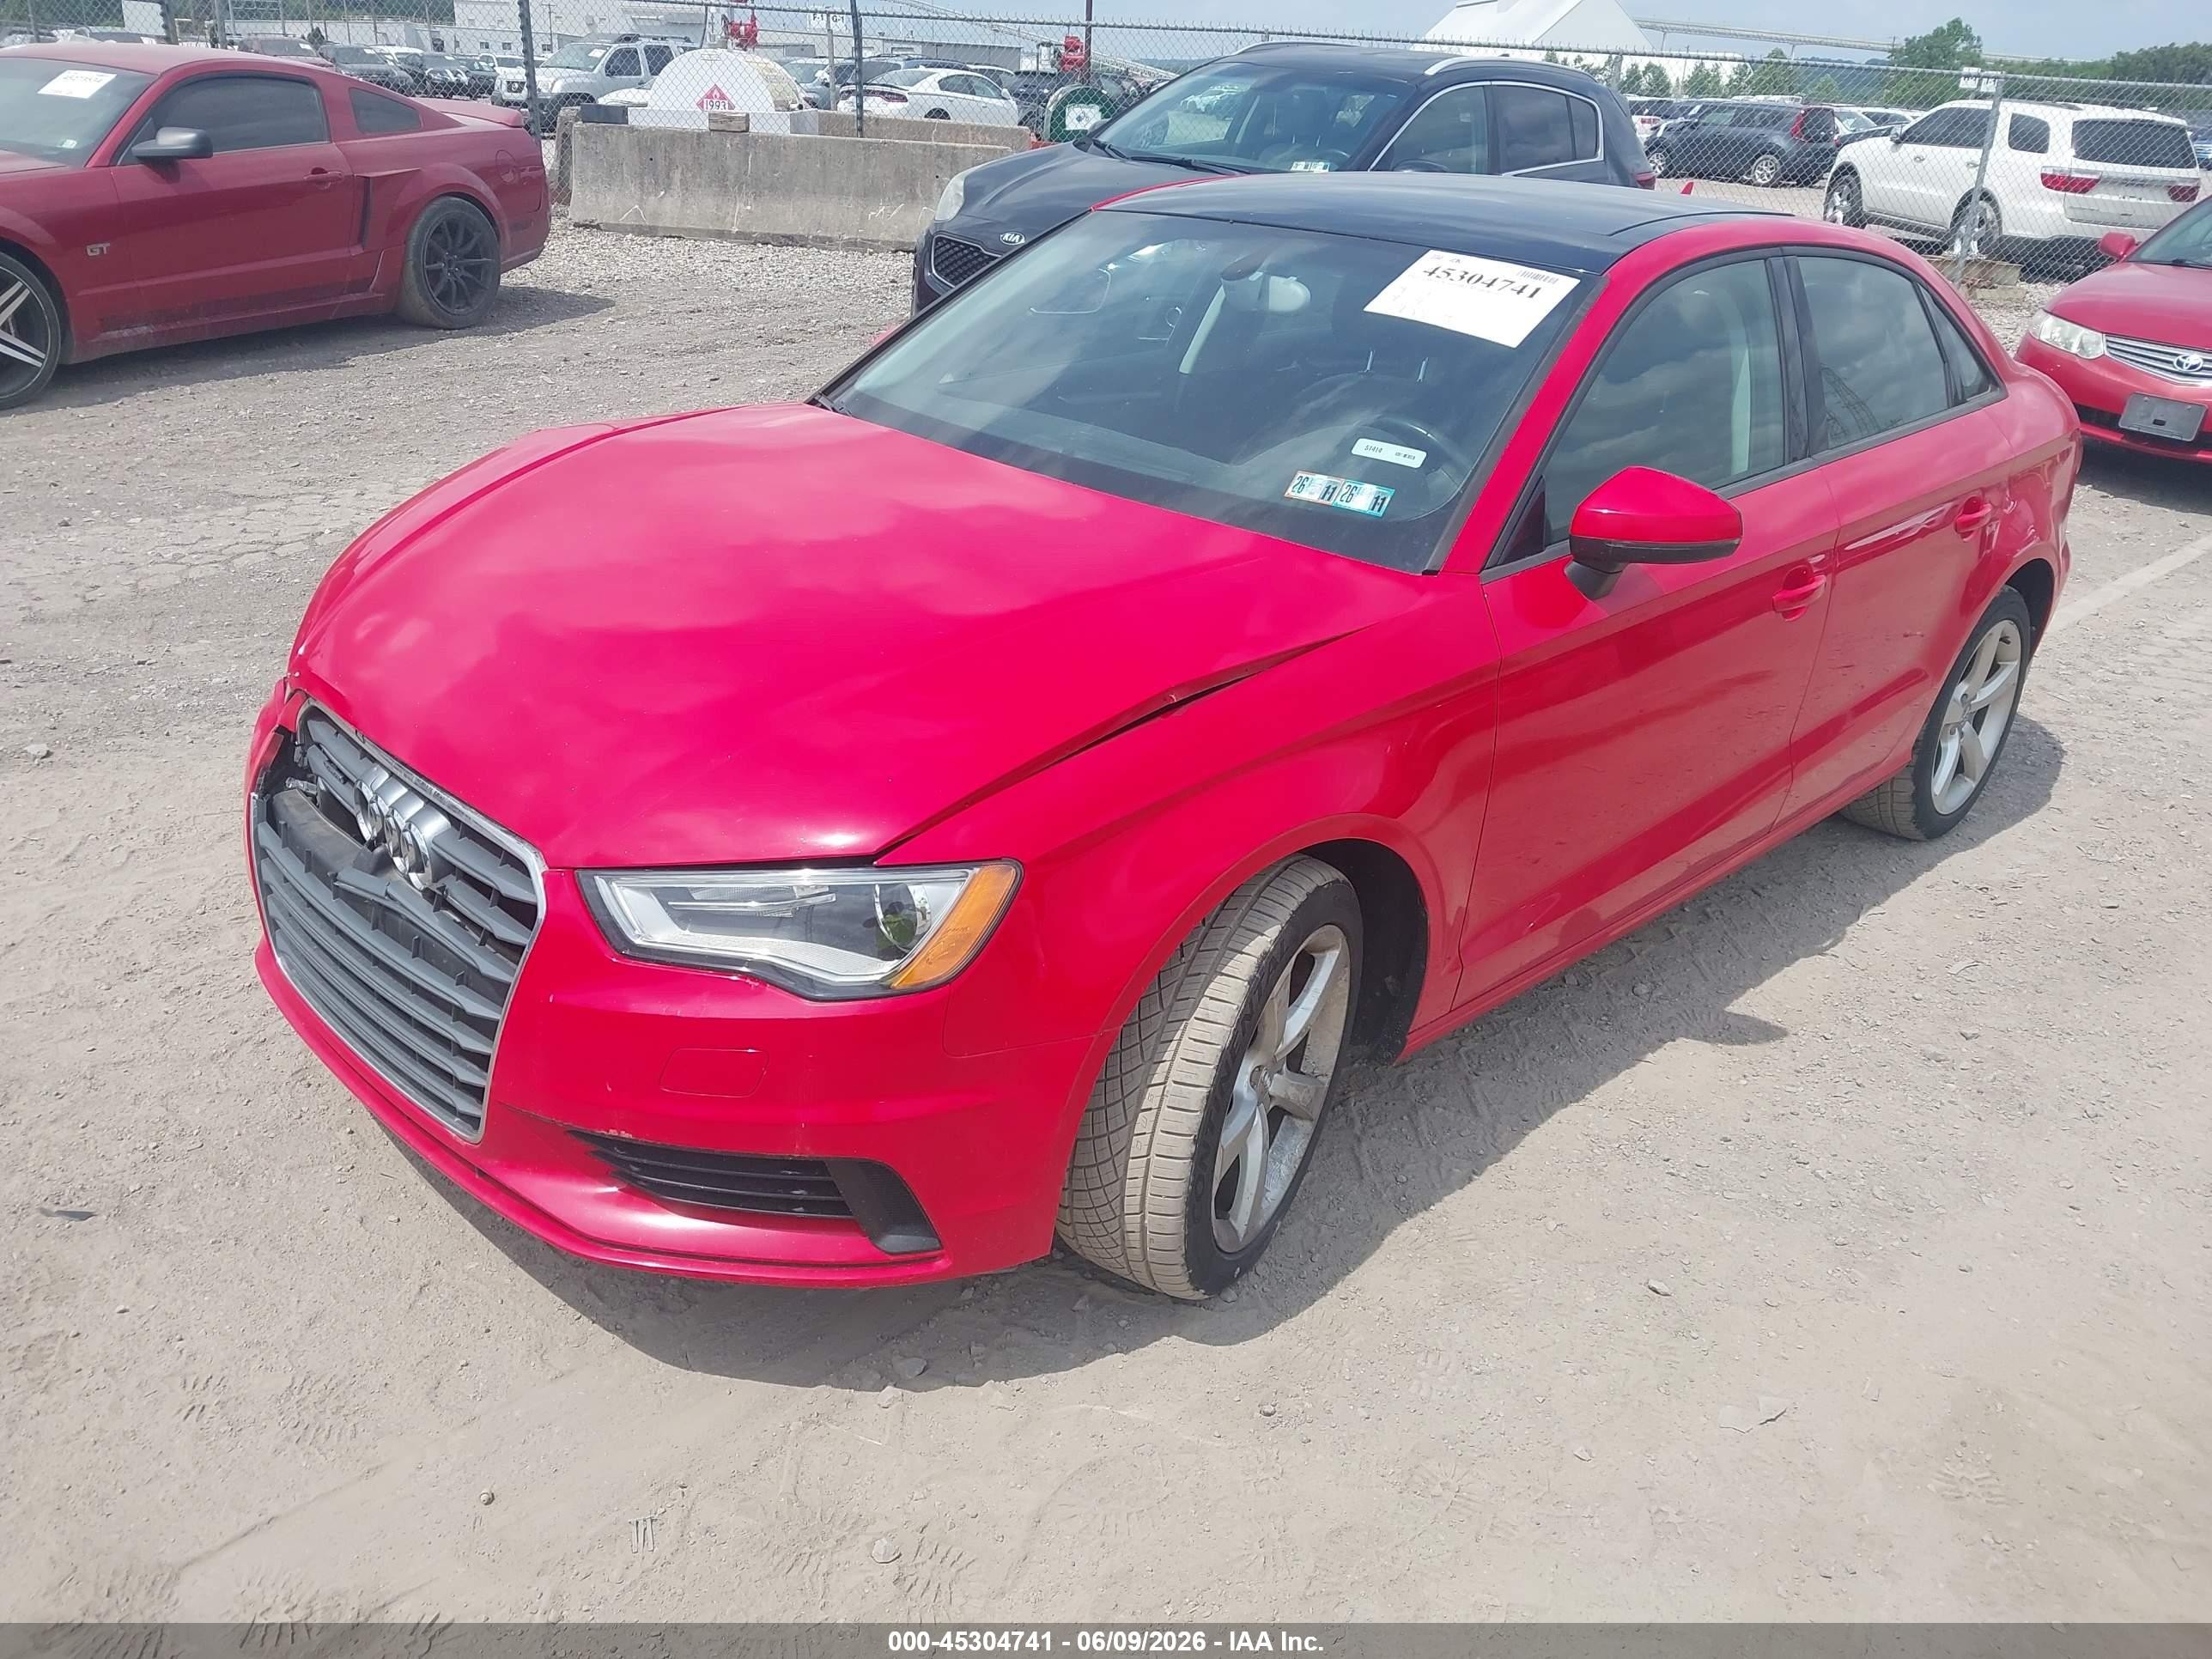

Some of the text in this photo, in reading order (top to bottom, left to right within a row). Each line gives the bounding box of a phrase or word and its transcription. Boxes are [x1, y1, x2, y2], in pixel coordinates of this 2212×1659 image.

[86, 242, 111, 257] GT
[1002, 233, 1020, 243] KIA
[1423, 265, 1542, 299] 45304741
[1291, 475, 1339, 502] 26 11
[1340, 484, 1388, 513] 26 11
